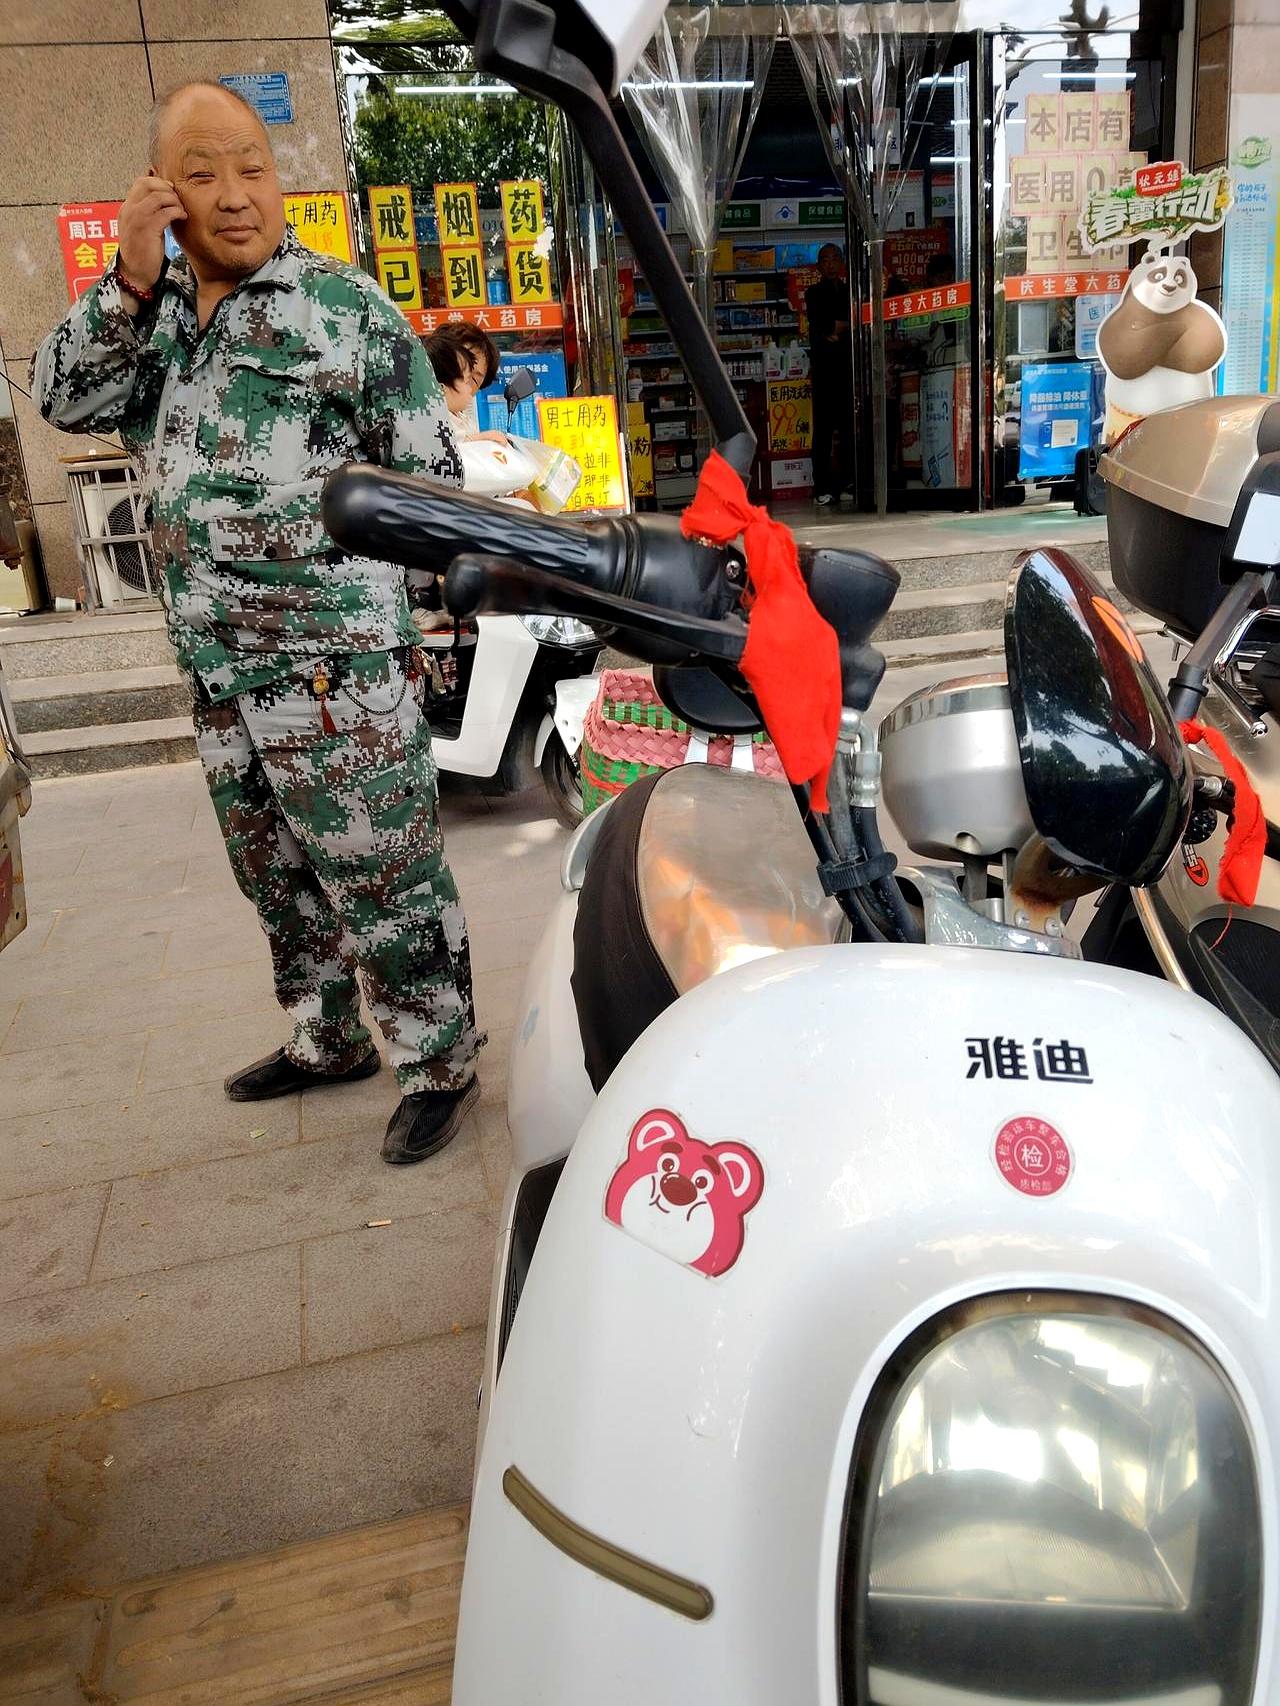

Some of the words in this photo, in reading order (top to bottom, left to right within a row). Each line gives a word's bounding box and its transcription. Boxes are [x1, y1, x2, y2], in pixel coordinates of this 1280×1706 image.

[1030, 107, 1126, 143] 本店有
[287, 200, 337, 227] 士用药
[376, 188, 538, 241] 戒烟药
[68, 220, 105, 240] 周五
[383, 250, 545, 303] 已到货
[1020, 274, 1122, 296] 庆生堂大药
[889, 288, 958, 316] 生堂大药房
[403, 308, 543, 332] 生堂大药房
[547, 402, 606, 429] 男士用药
[629, 436, 650, 457] 粉
[964, 1035, 1094, 1085] 雅迪
[1020, 1143, 1045, 1168] 检
